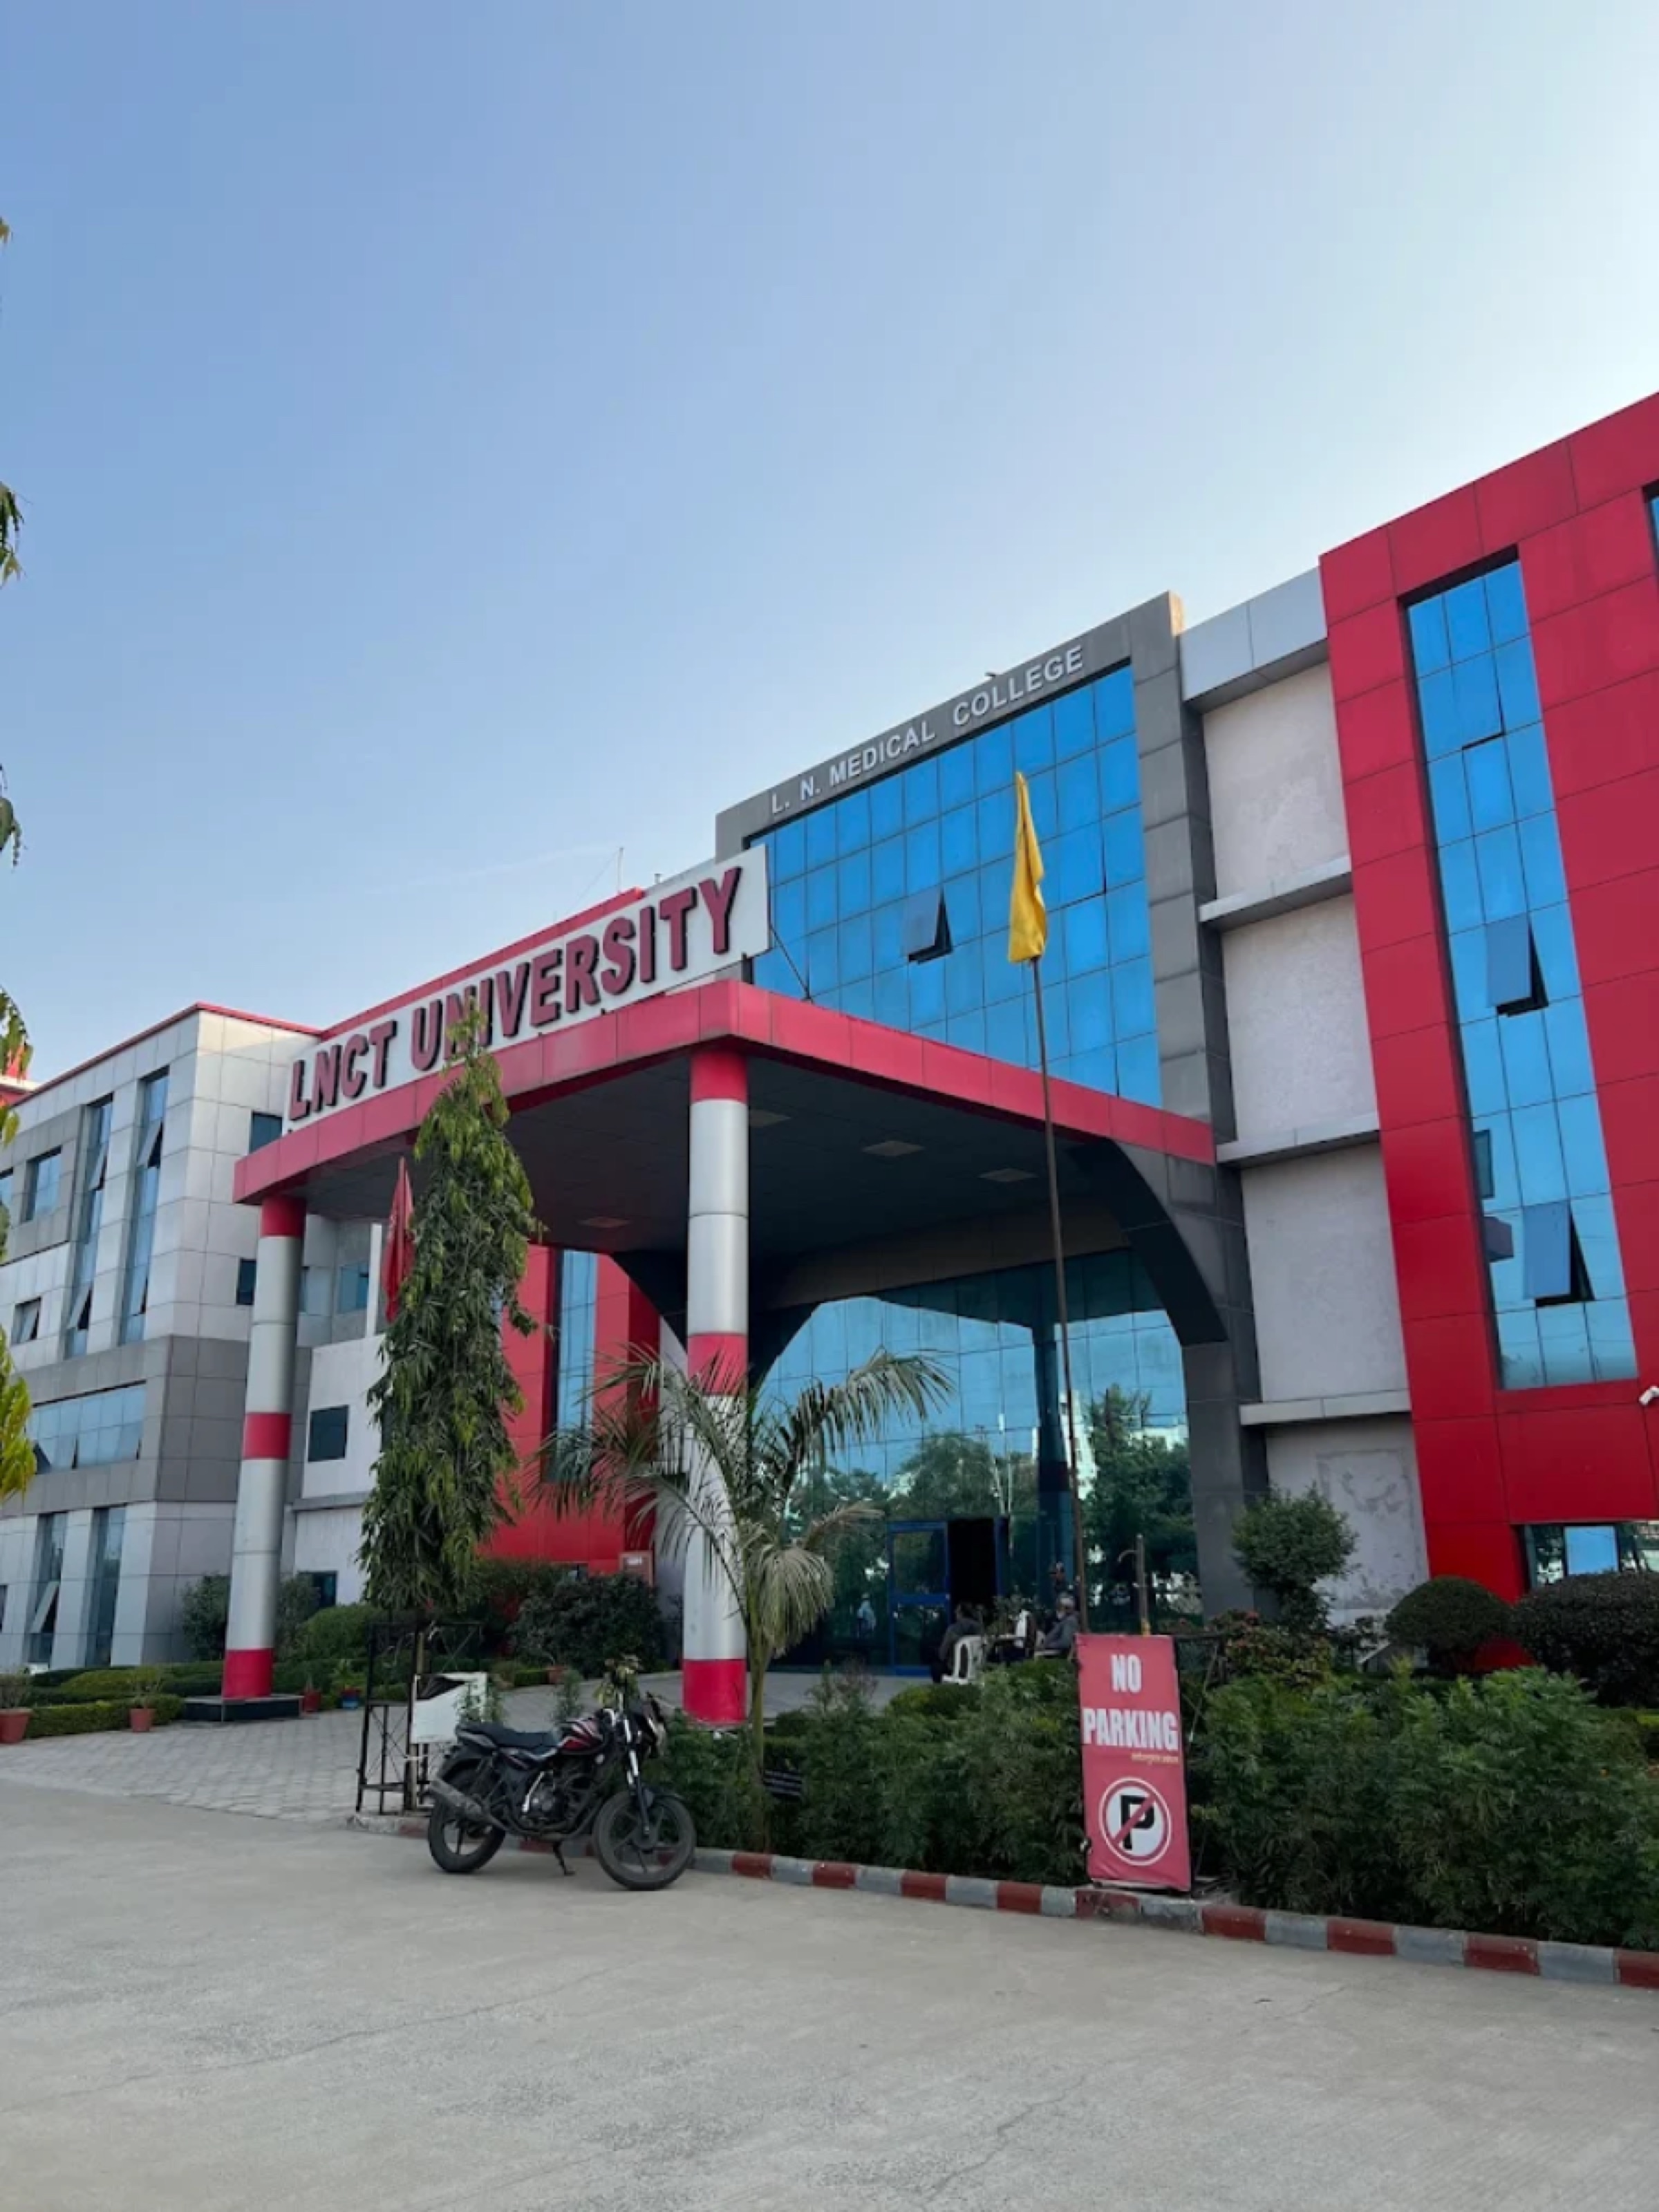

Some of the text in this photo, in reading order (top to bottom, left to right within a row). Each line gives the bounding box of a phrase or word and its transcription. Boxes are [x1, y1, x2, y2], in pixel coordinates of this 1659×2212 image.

[772, 645, 1083, 814] L. N. MEDICAL COLLEGE
[290, 1020, 399, 1121] LNCT
[1111, 1654, 1142, 1693] NO
[1082, 1707, 1179, 1751] PARKING
